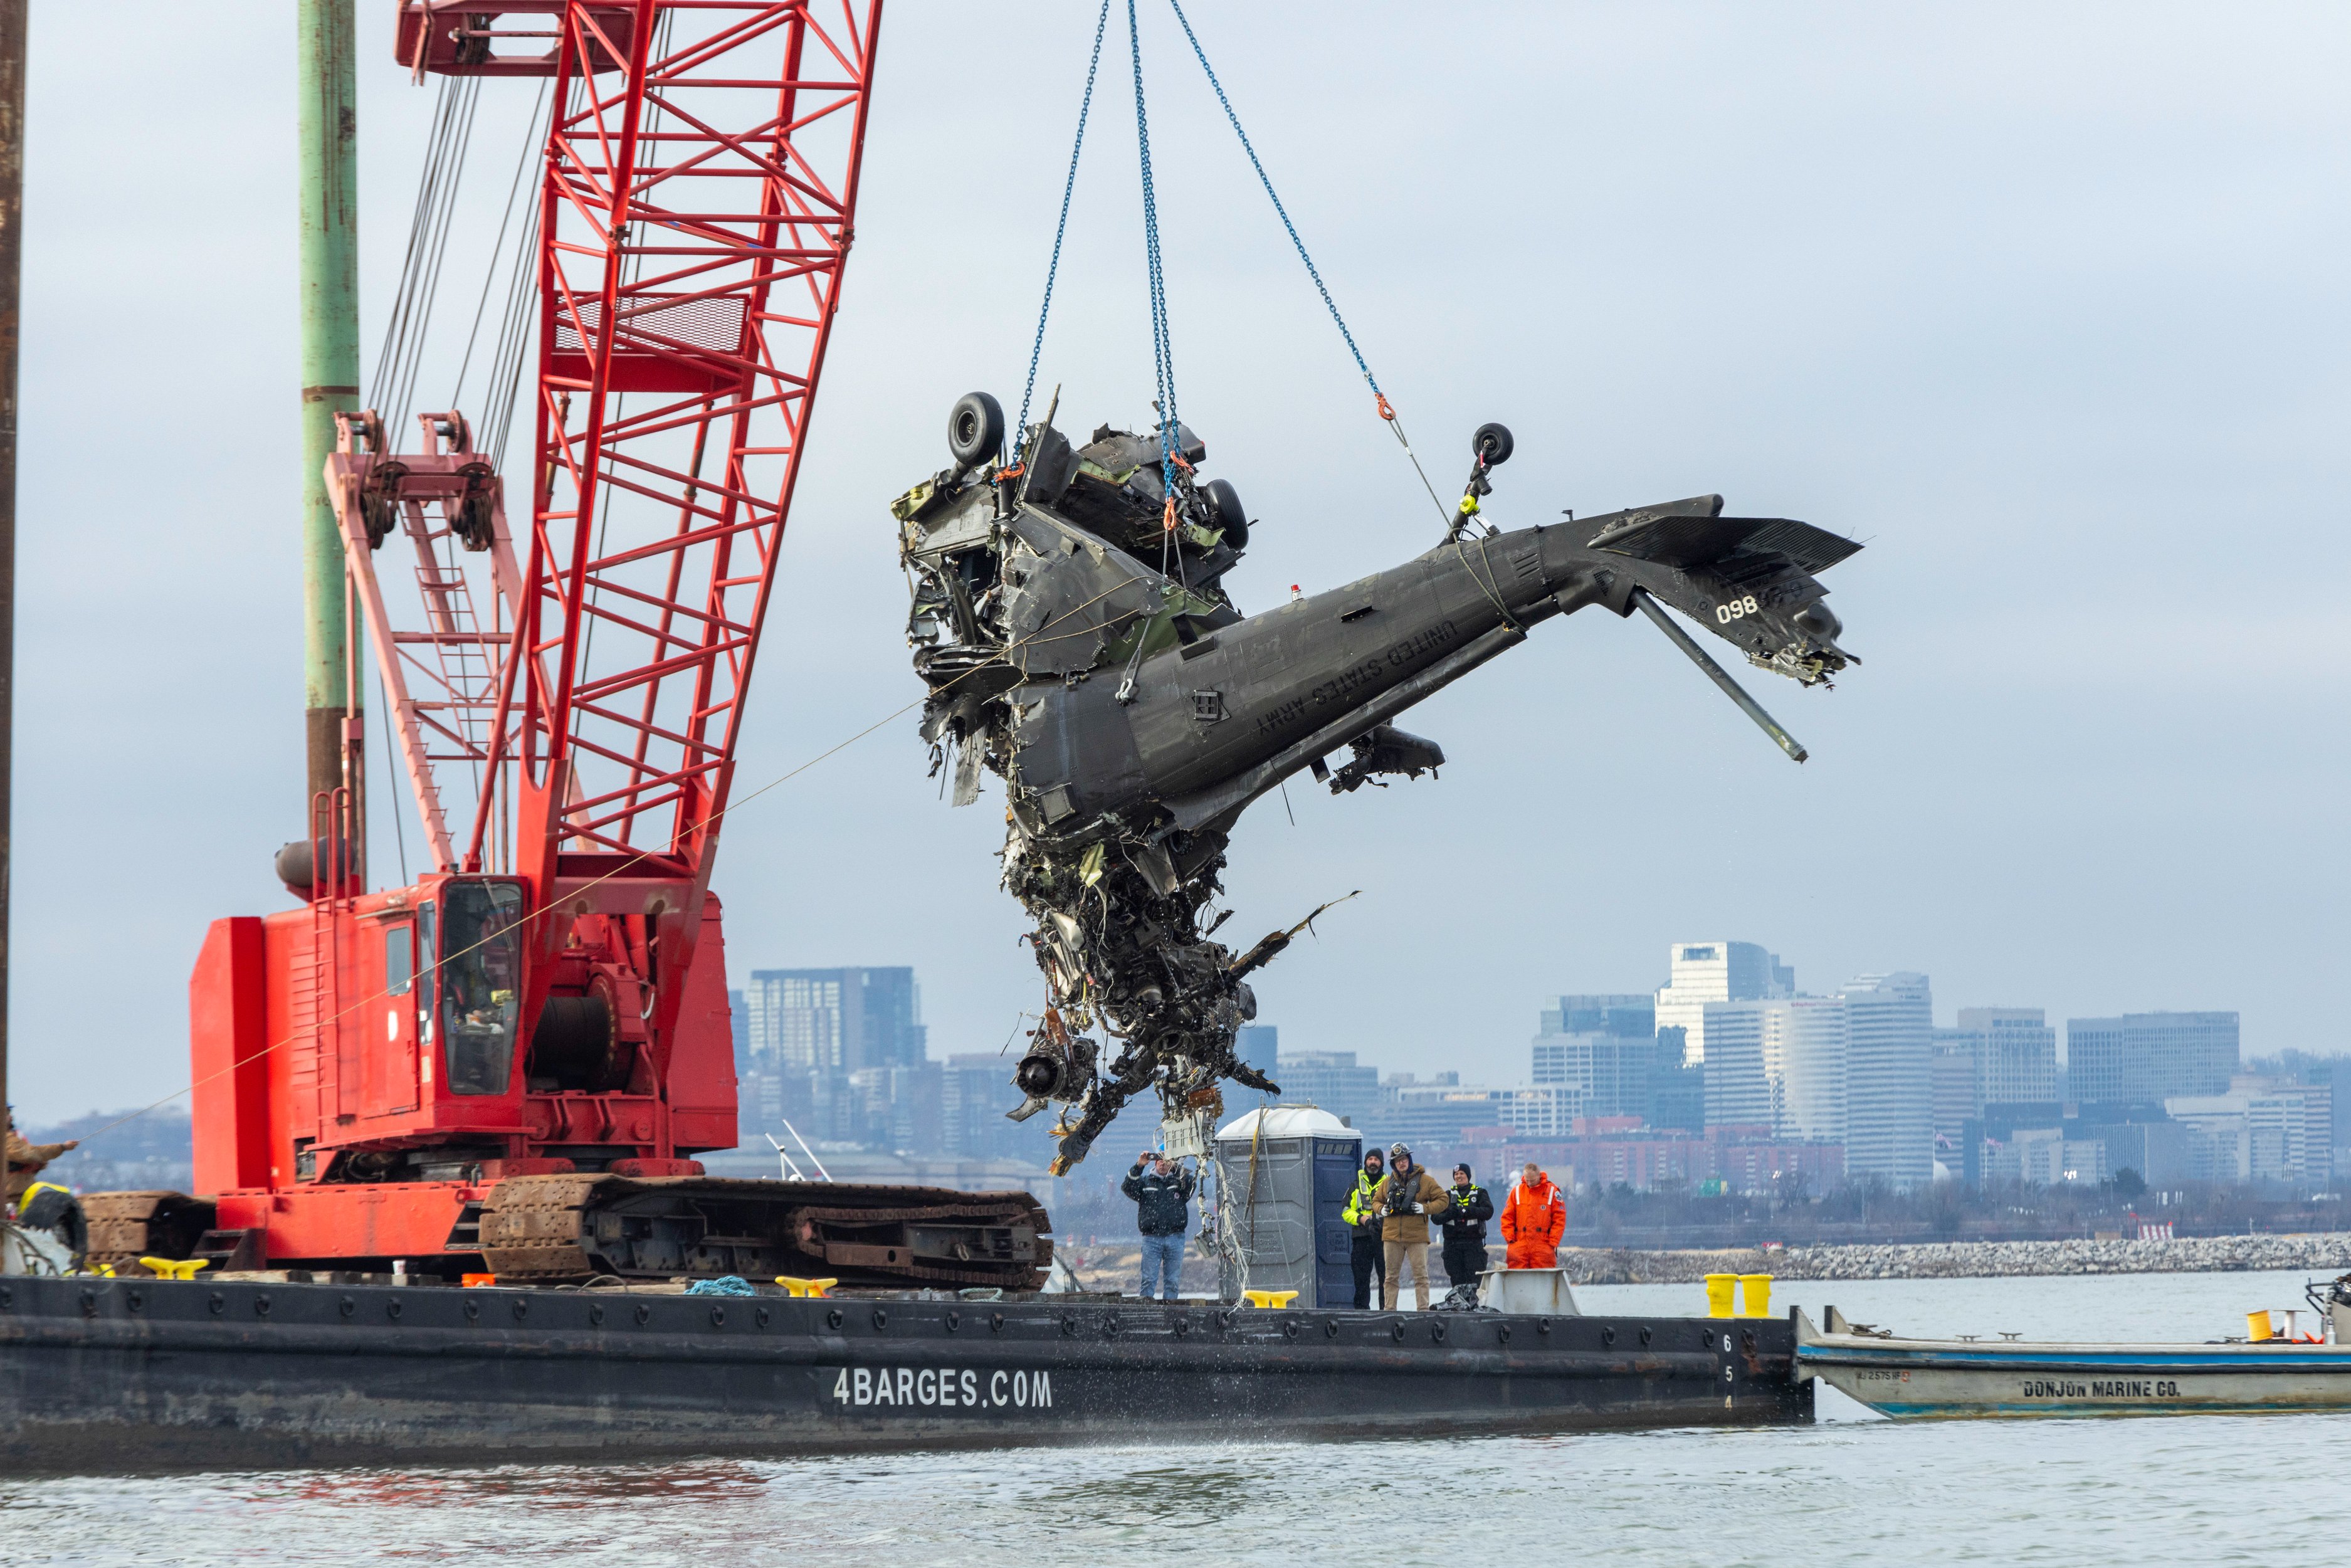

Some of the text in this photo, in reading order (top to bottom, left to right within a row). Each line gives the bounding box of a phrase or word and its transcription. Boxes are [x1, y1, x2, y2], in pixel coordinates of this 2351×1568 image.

[1256, 619, 1458, 735] UNITED STATES ARMY
[1723, 1334, 1732, 1352] 6
[1725, 1365, 1733, 1382] 5
[1868, 1371, 1891, 1380] 2575
[833, 1367, 1052, 1408] 4BARGES.COM
[2022, 1381, 2181, 1397] DONJON MARINE CO.
